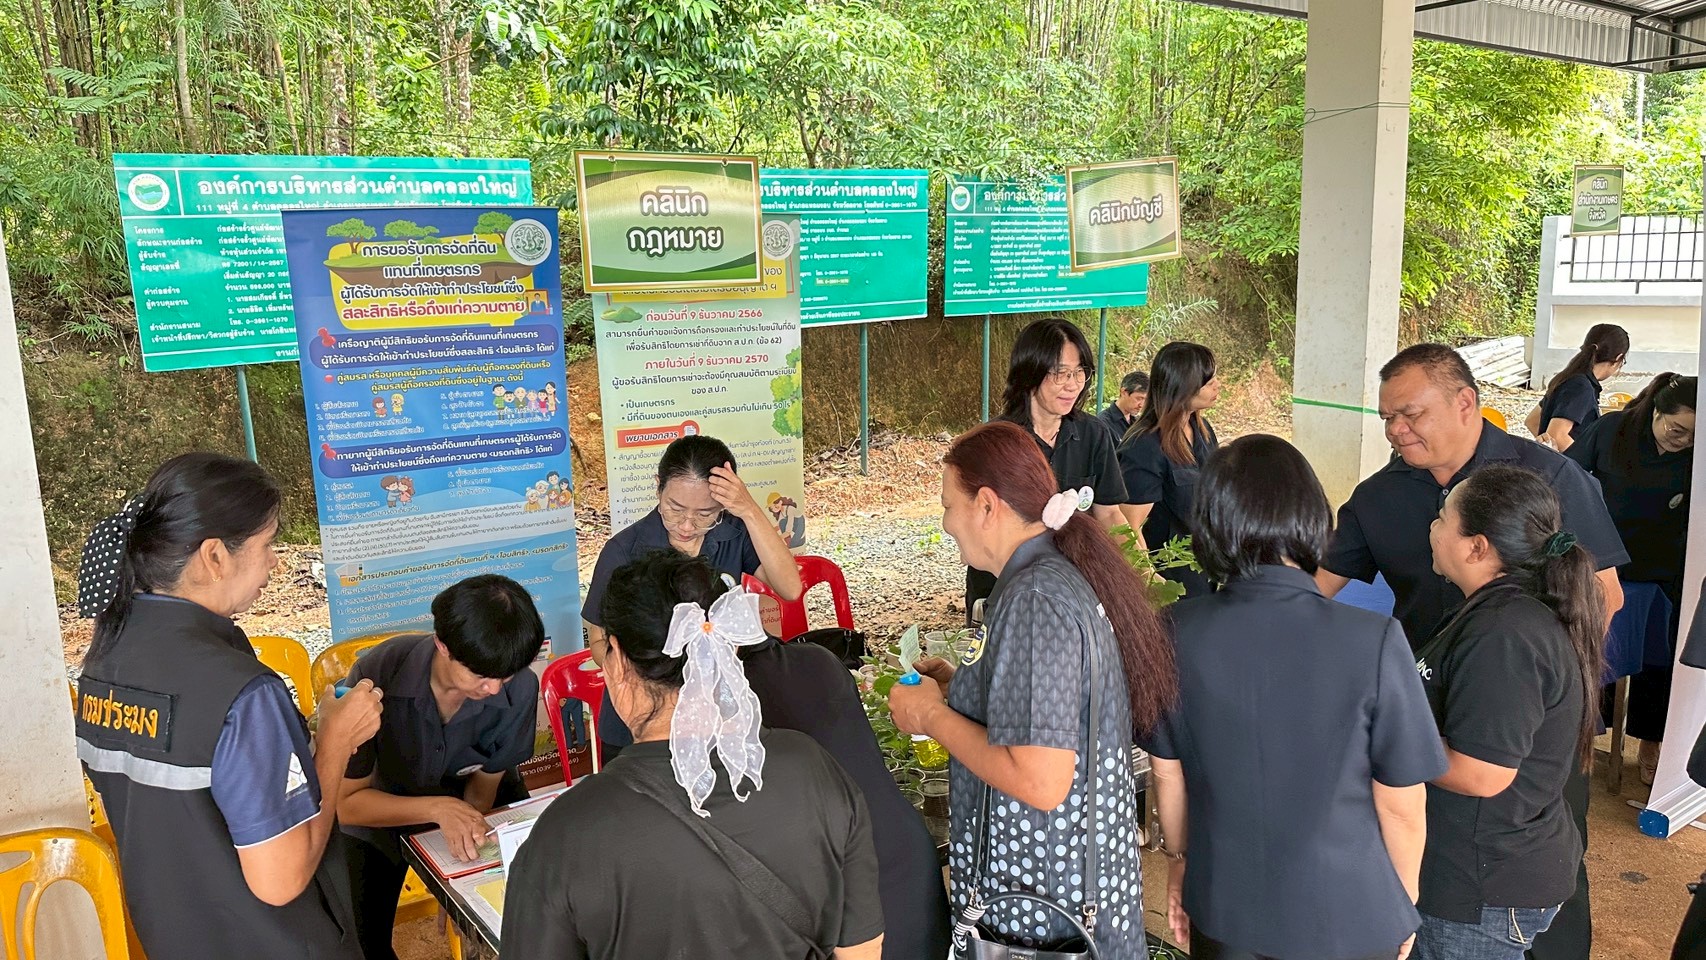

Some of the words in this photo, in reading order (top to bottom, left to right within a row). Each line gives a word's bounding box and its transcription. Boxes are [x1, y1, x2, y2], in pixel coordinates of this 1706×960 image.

[197, 174, 517, 198] องค์การบริหารส่วนตำบลคลองใหญ่
[641, 188, 709, 215] คลินิก
[1088, 195, 1164, 226] คลินิกบัญชี
[362, 235, 497, 257] การขอรับการจัดที่ดิน
[627, 229, 724, 256] กฎหมาย
[383, 258, 481, 278] แทนที่เกษตรกร
[340, 276, 525, 304] ผู้ได้รับการจัดให้เข้าทำประโยชน์ซึ่ง
[342, 299, 525, 321] สละสิทธิหรือถึงแก่ความตาย
[646, 304, 688, 322] ก่อนวันที่
[689, 311, 697, 320] 9
[699, 309, 736, 320] ธันวาคม
[738, 309, 763, 318] 2566
[338, 329, 539, 350] เครือญาติผู้มีสิทธิขอรับการจัดที่ดินแทนที่เกษตรกร
[536, 342, 555, 353] ได้แก่
[626, 335, 732, 352] เพื่อรับสิทธิโดยการเช่าที่ดินจาก
[770, 335, 782, 345] 62)
[645, 352, 695, 370] ภายในวันที่
[697, 358, 704, 367] 9
[706, 356, 743, 366] ธันวาคม
[744, 354, 769, 364] 2570
[337, 372, 367, 385] คู่สมรส
[691, 387, 706, 395] ของ
[625, 397, 675, 409] เป็นเกษตรกร
[625, 430, 679, 443] พยานเอกสาร
[535, 443, 554, 454] ได้แก่
[82, 689, 158, 738] กรมประมง
